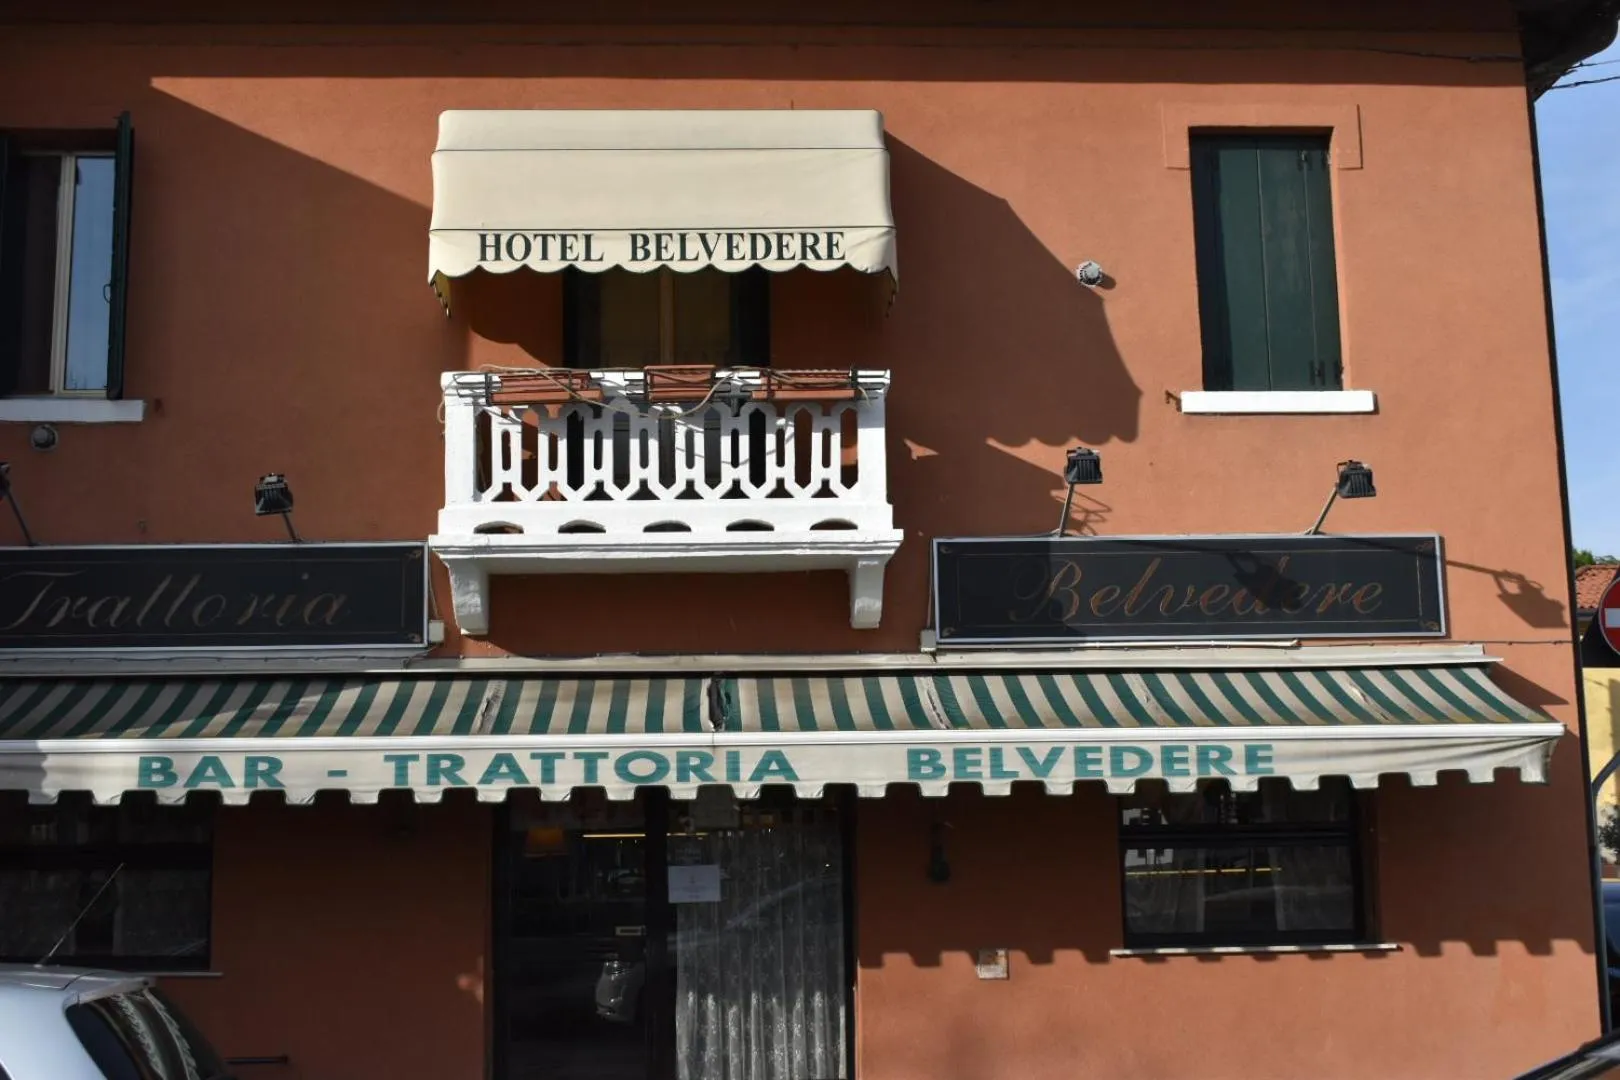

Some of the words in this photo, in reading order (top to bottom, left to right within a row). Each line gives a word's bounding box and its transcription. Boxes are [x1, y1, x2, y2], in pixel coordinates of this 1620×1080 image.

[478, 232, 604, 262] HOTEL
[628, 231, 847, 261] BELVEDERE
[1006, 554, 1384, 622] Belvedere
[137, 755, 285, 790] BAR
[385, 750, 800, 786] TRATTORIA
[907, 744, 1275, 780] BELVEDERE
